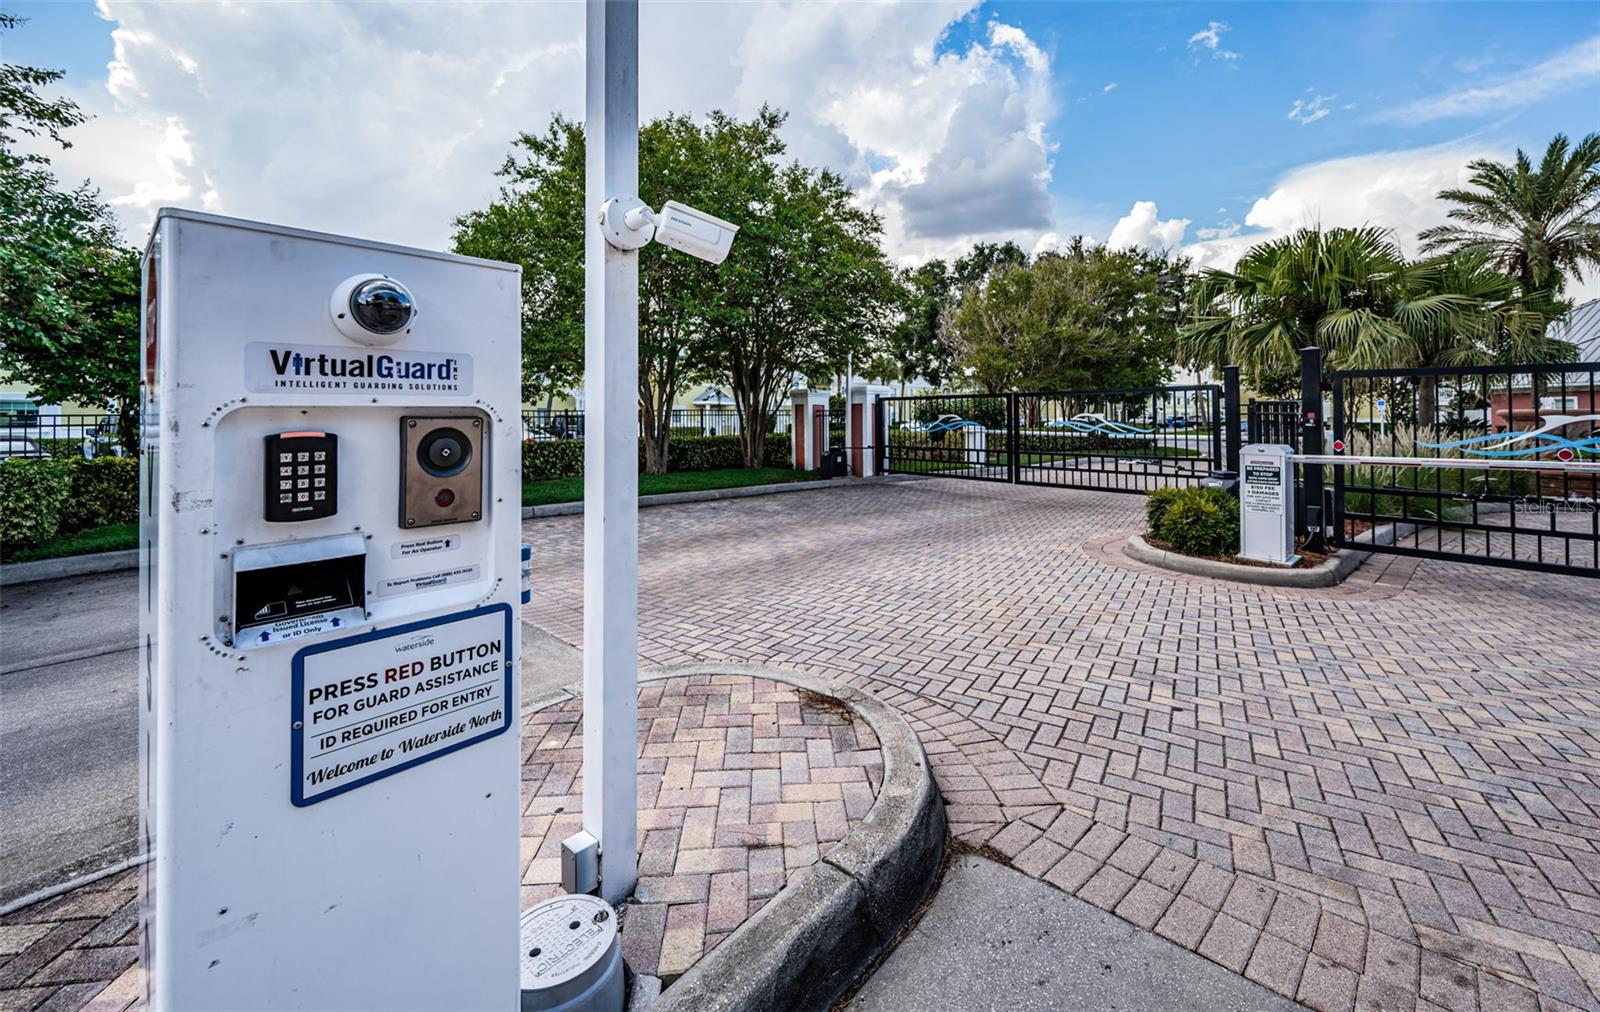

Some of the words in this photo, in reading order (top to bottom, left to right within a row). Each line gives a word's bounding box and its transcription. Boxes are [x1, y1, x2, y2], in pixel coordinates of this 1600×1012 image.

[275, 379, 347, 389] INTELLIGENT
[353, 381, 404, 391] GUARDING
[409, 383, 458, 391] SOLUTIONS
[420, 545, 442, 553] Operator
[272, 623, 298, 633] Issued
[300, 617, 328, 628] License
[304, 626, 322, 636] Only
[309, 673, 378, 705] PRESS
[384, 661, 424, 684] RED
[430, 639, 501, 671] BUTTON
[313, 704, 349, 724] FOR
[353, 686, 410, 712] GUARD
[414, 660, 499, 695] ASSISTANCE
[320, 735, 337, 750] ID
[341, 709, 418, 744] REQUIRED
[421, 700, 449, 717] FOR
[452, 686, 493, 707] ENTRY
[306, 753, 378, 786] Welcome
[380, 748, 394, 762] to
[398, 721, 467, 754] Waterside
[469, 708, 502, 731] North
[536, 928, 600, 973] ELECTRIC
